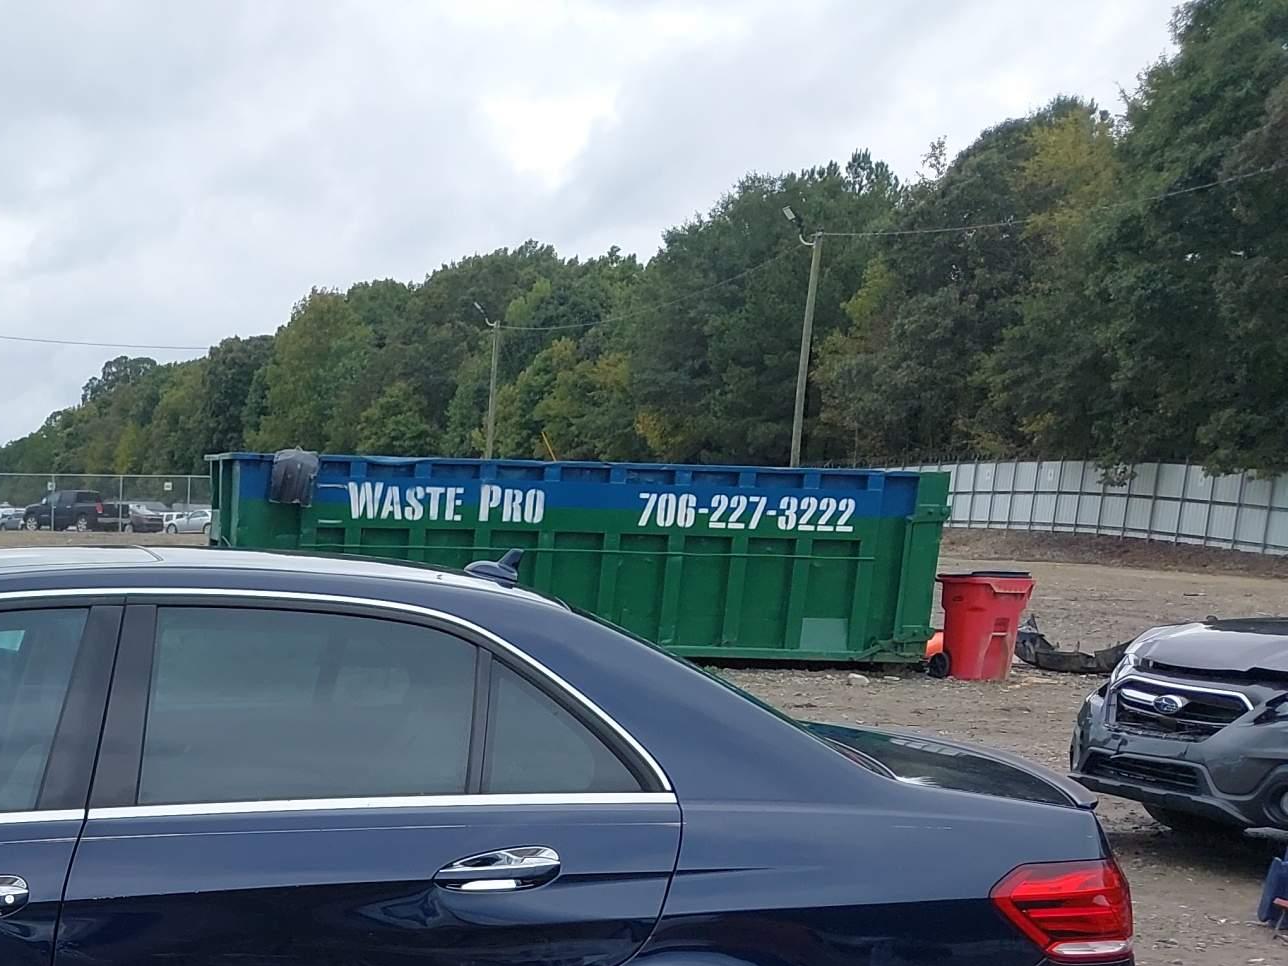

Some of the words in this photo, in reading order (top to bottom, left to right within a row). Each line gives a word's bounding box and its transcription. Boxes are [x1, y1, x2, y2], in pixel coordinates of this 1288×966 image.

[348, 481, 464, 521] WASTE
[478, 484, 545, 524] PRO
[638, 493, 856, 532] 706-227-3222
